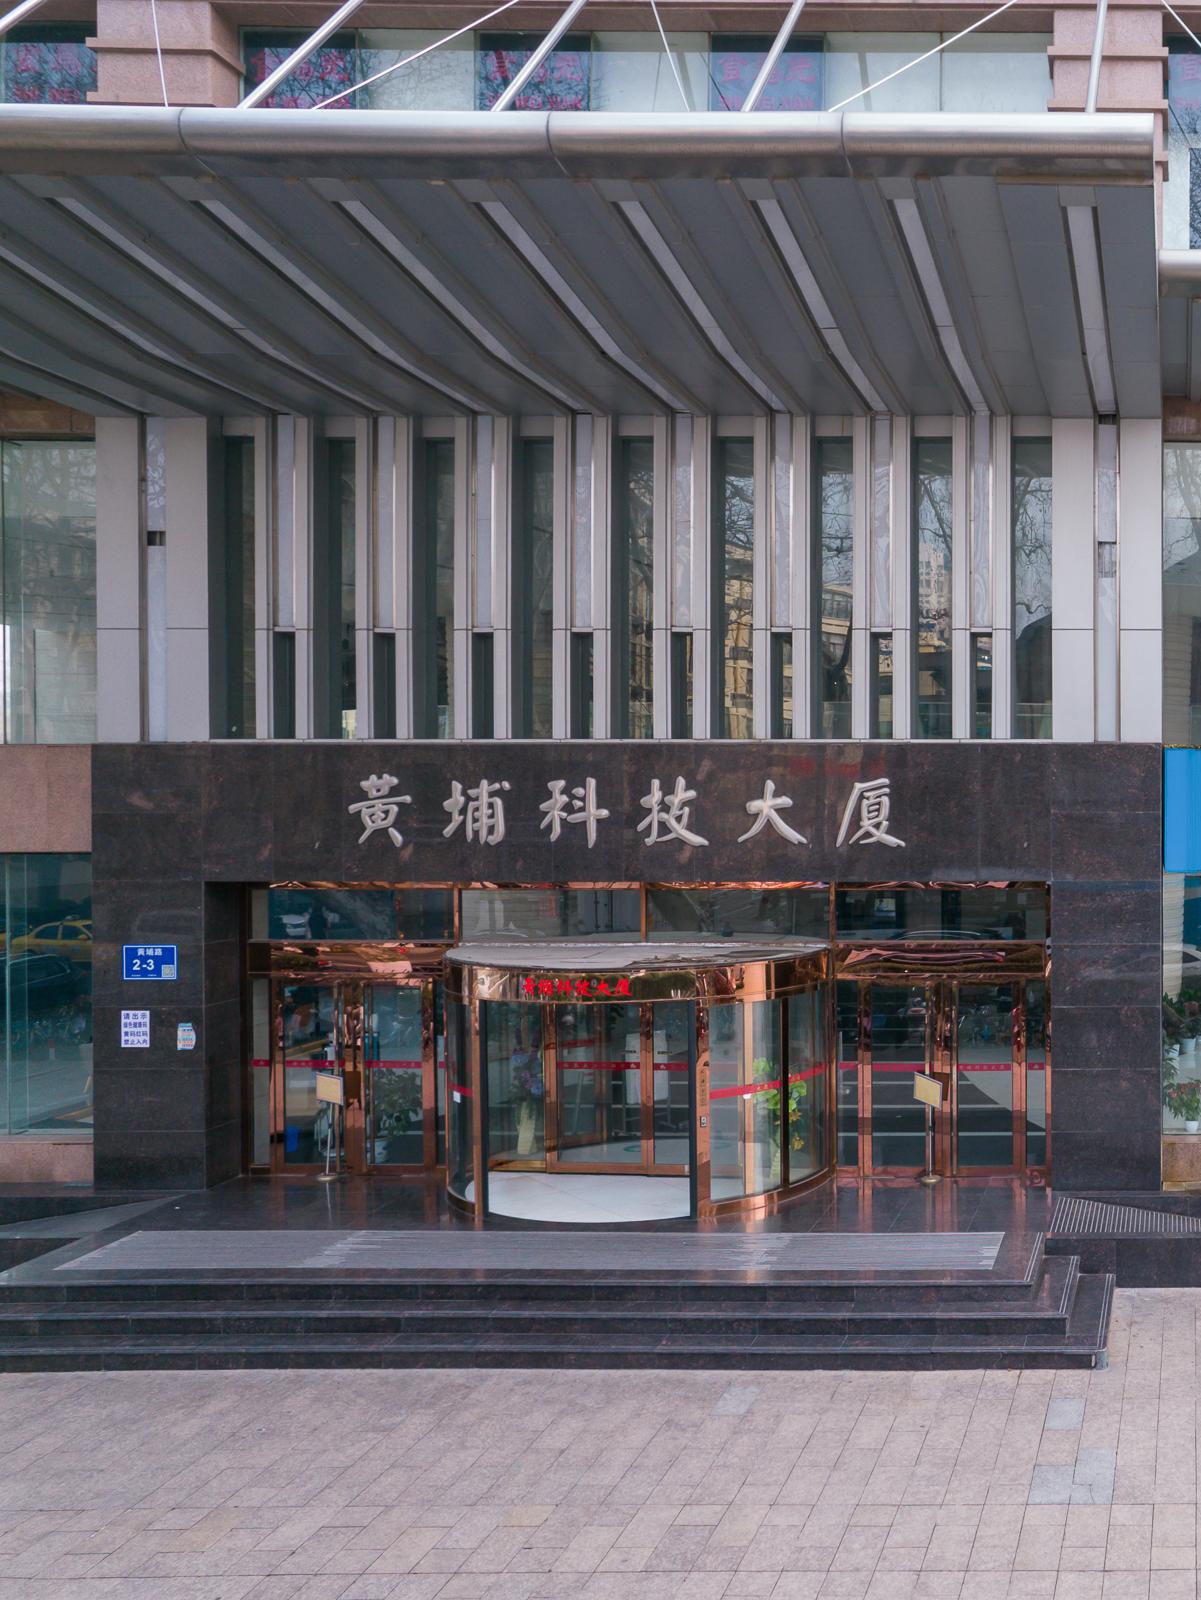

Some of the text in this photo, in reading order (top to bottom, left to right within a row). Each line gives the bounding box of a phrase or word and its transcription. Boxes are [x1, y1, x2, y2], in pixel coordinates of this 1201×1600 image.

[137, 948, 162, 956] 黄埔路
[132, 958, 155, 971] 2-3
